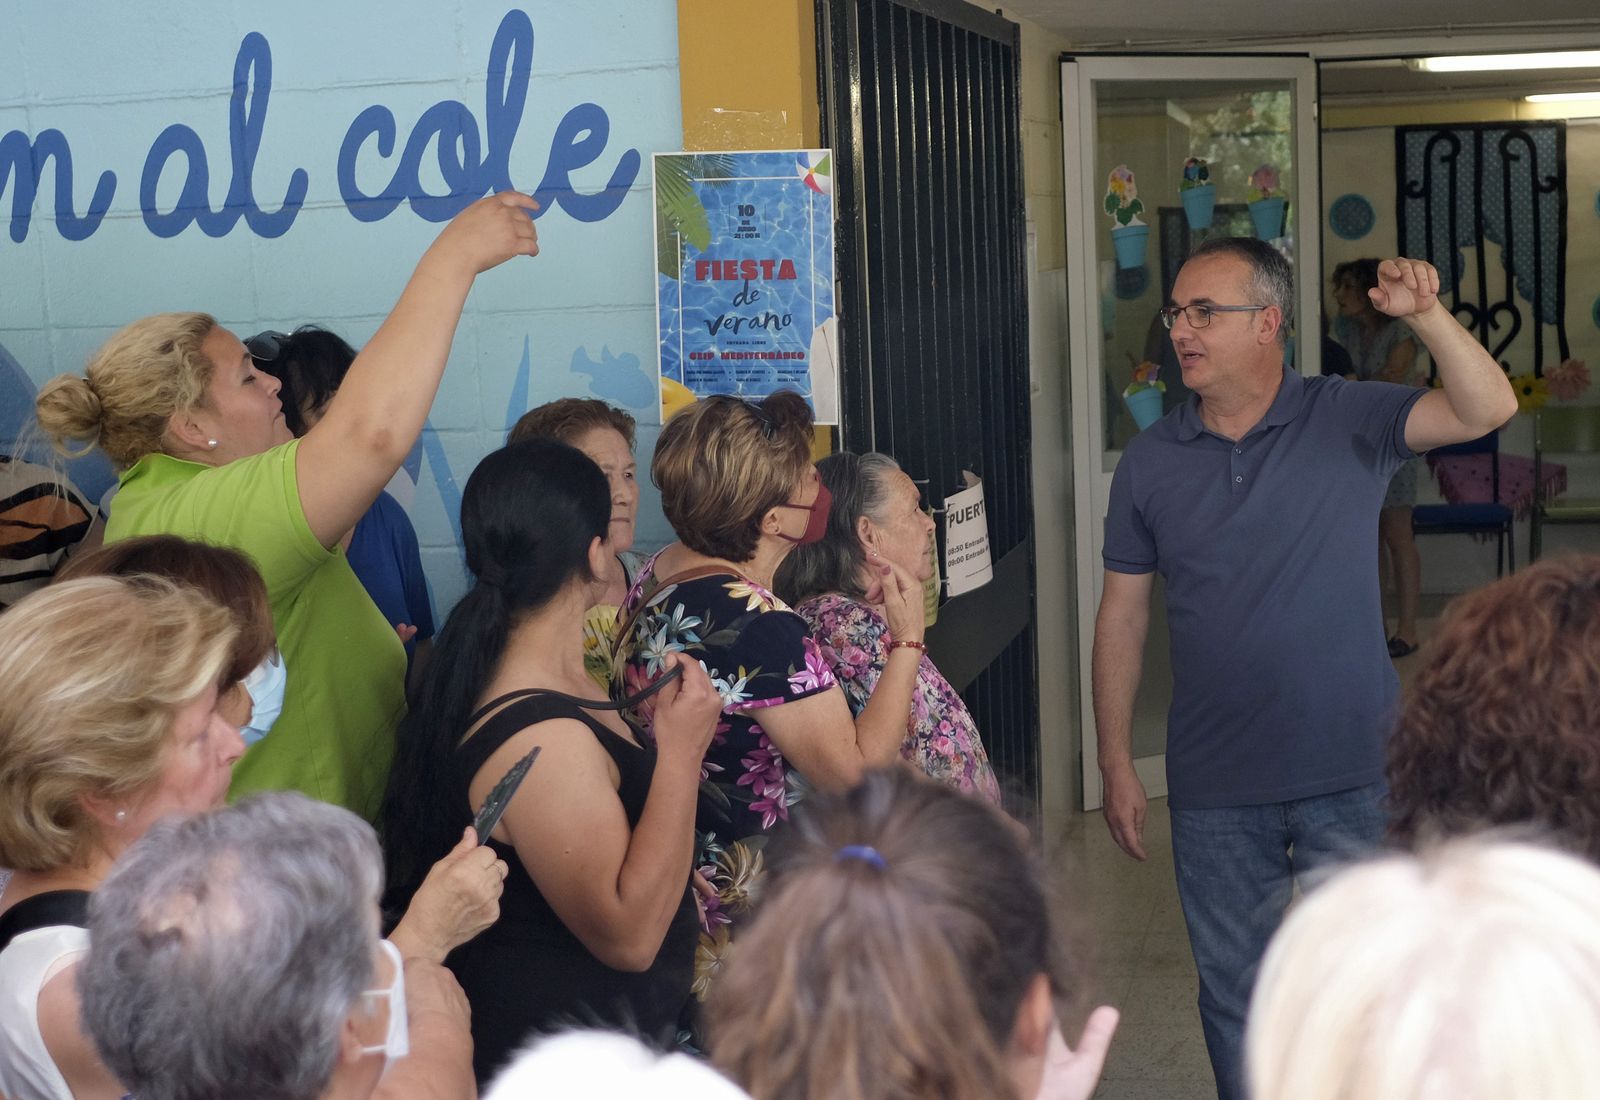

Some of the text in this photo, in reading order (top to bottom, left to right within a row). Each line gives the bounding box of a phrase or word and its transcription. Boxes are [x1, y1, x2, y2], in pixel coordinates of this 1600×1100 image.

[140, 31, 308, 240] al
[337, 8, 641, 223] cole
[738, 204, 755, 217] 10
[695, 259, 797, 281] FIESTA
[733, 279, 760, 307] de
[704, 313, 792, 336] verano
